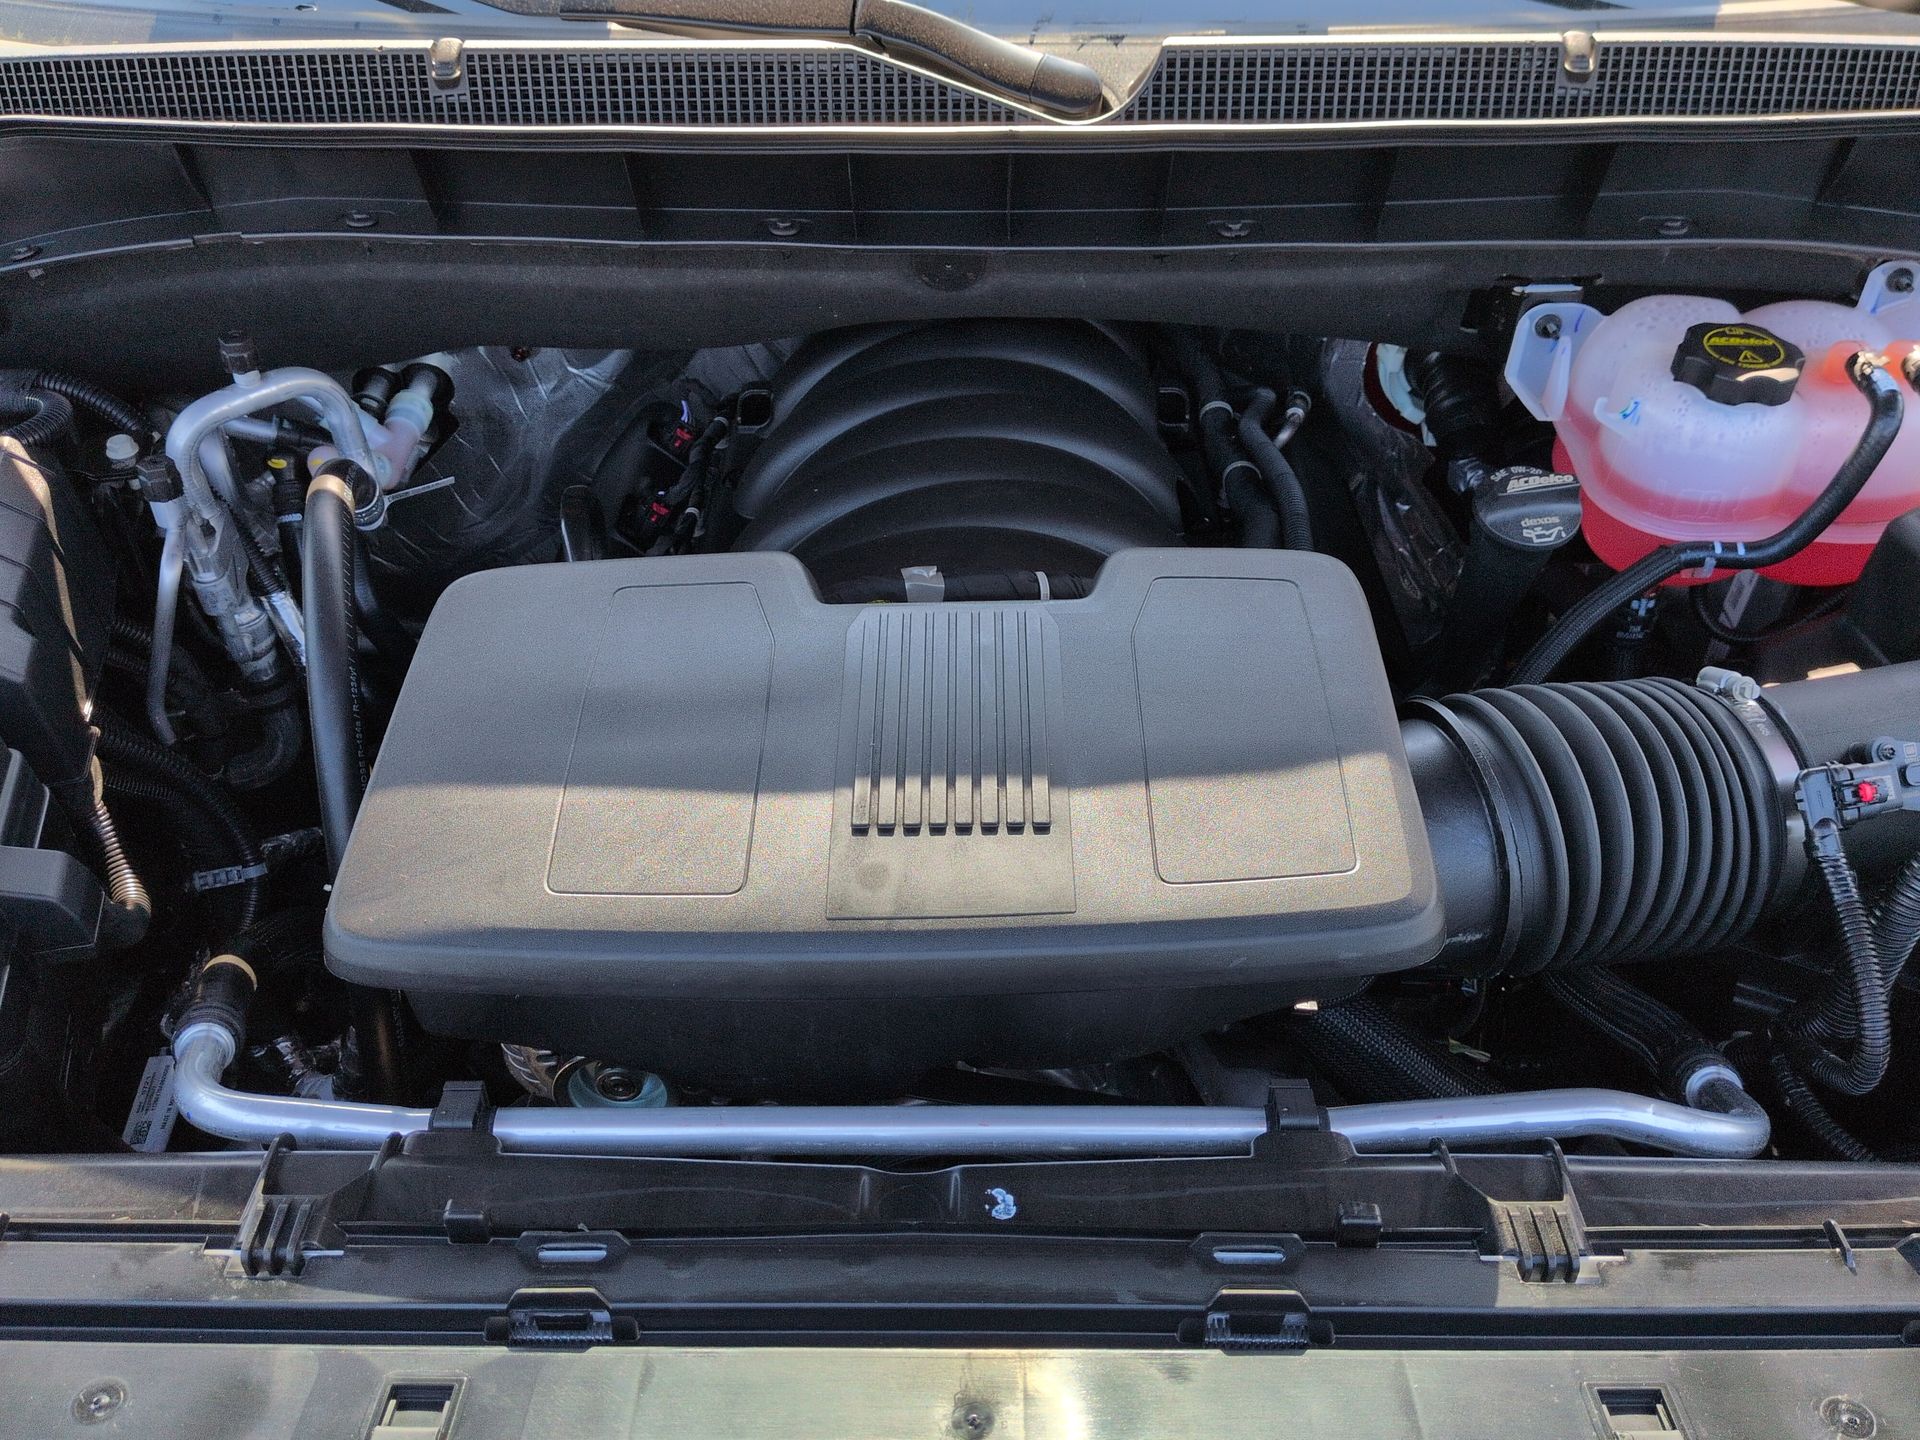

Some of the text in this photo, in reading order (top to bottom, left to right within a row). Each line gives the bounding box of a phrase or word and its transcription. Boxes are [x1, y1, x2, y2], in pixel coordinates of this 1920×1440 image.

[1490, 465, 1542, 482] SAE 0W-20
[1506, 474, 1574, 492] ACDelco
[1521, 516, 1560, 527] dexos
